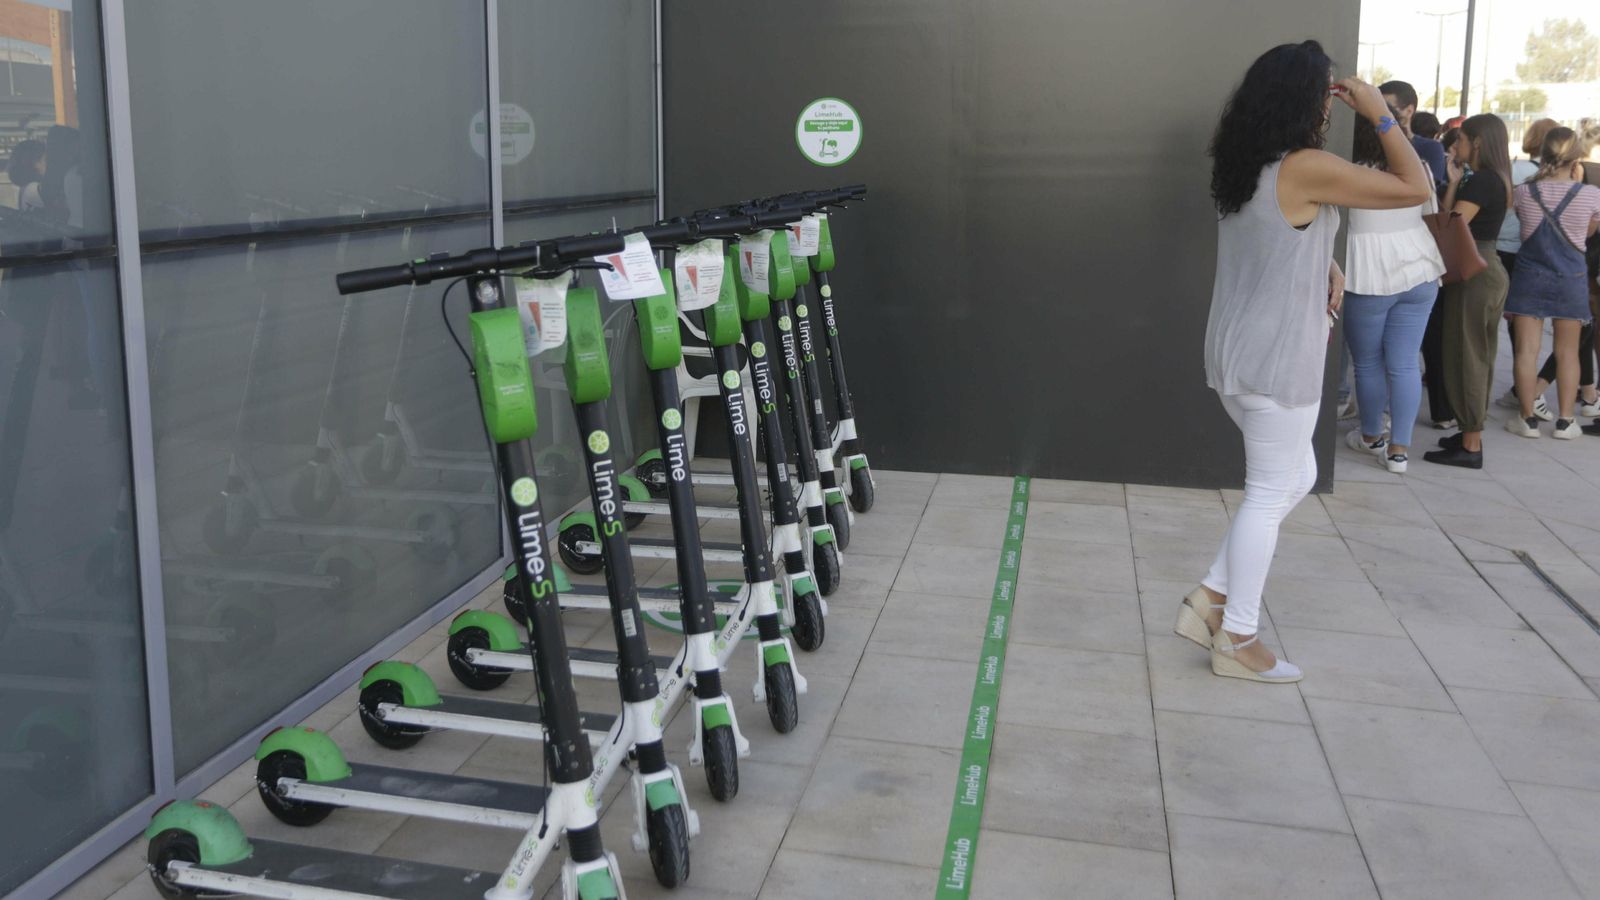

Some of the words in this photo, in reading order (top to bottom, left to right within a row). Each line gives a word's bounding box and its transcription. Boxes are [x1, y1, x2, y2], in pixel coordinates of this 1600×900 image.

[727, 392, 746, 435] Lime
[666, 433, 686, 482] Lime
[982, 655, 999, 684] LimeHub
[971, 705, 990, 740] LimeHub
[960, 764, 982, 806] LimeHub
[946, 837, 971, 890] LimeHub
